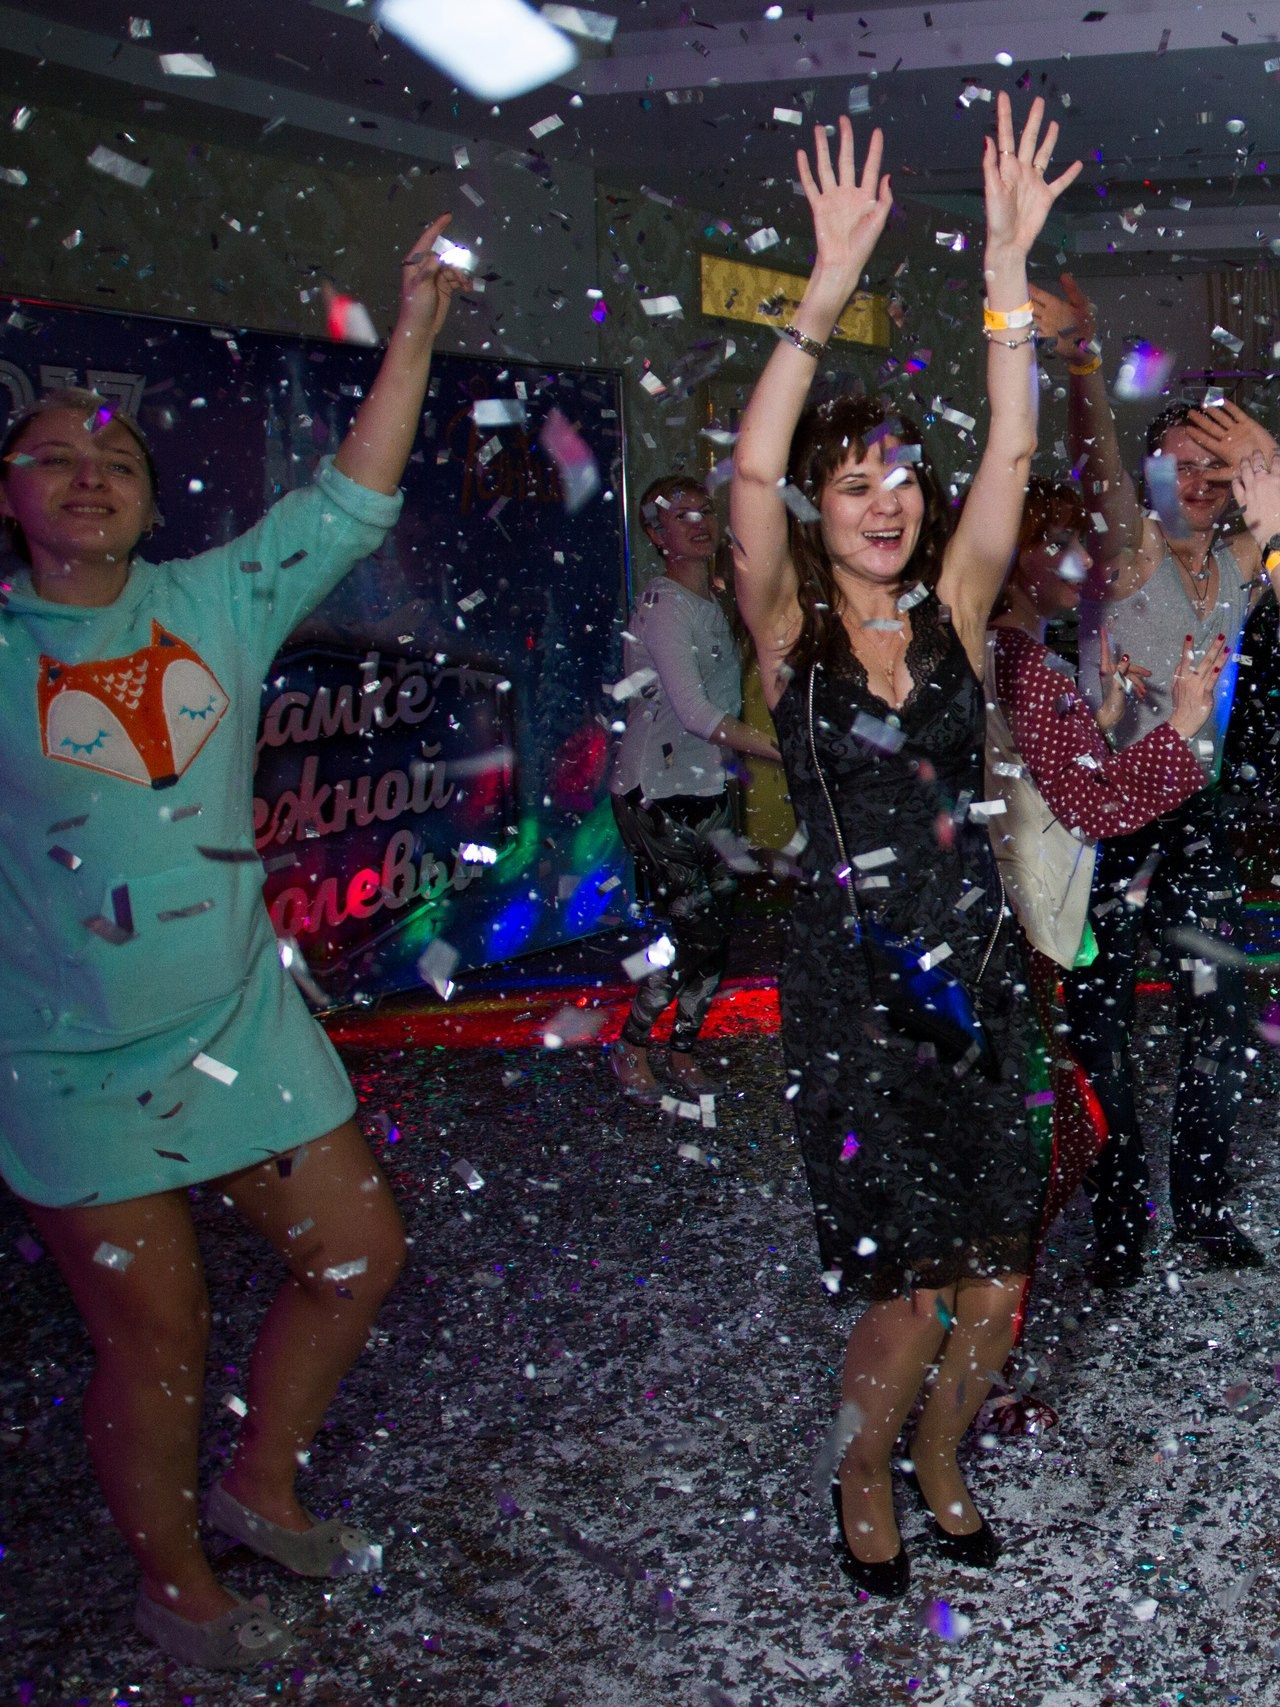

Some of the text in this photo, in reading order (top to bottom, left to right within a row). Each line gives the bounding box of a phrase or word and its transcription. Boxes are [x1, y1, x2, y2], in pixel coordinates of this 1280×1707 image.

[256, 651, 436, 755] амке
[254, 741, 456, 850] ежной
[270, 829, 478, 936] олевы
